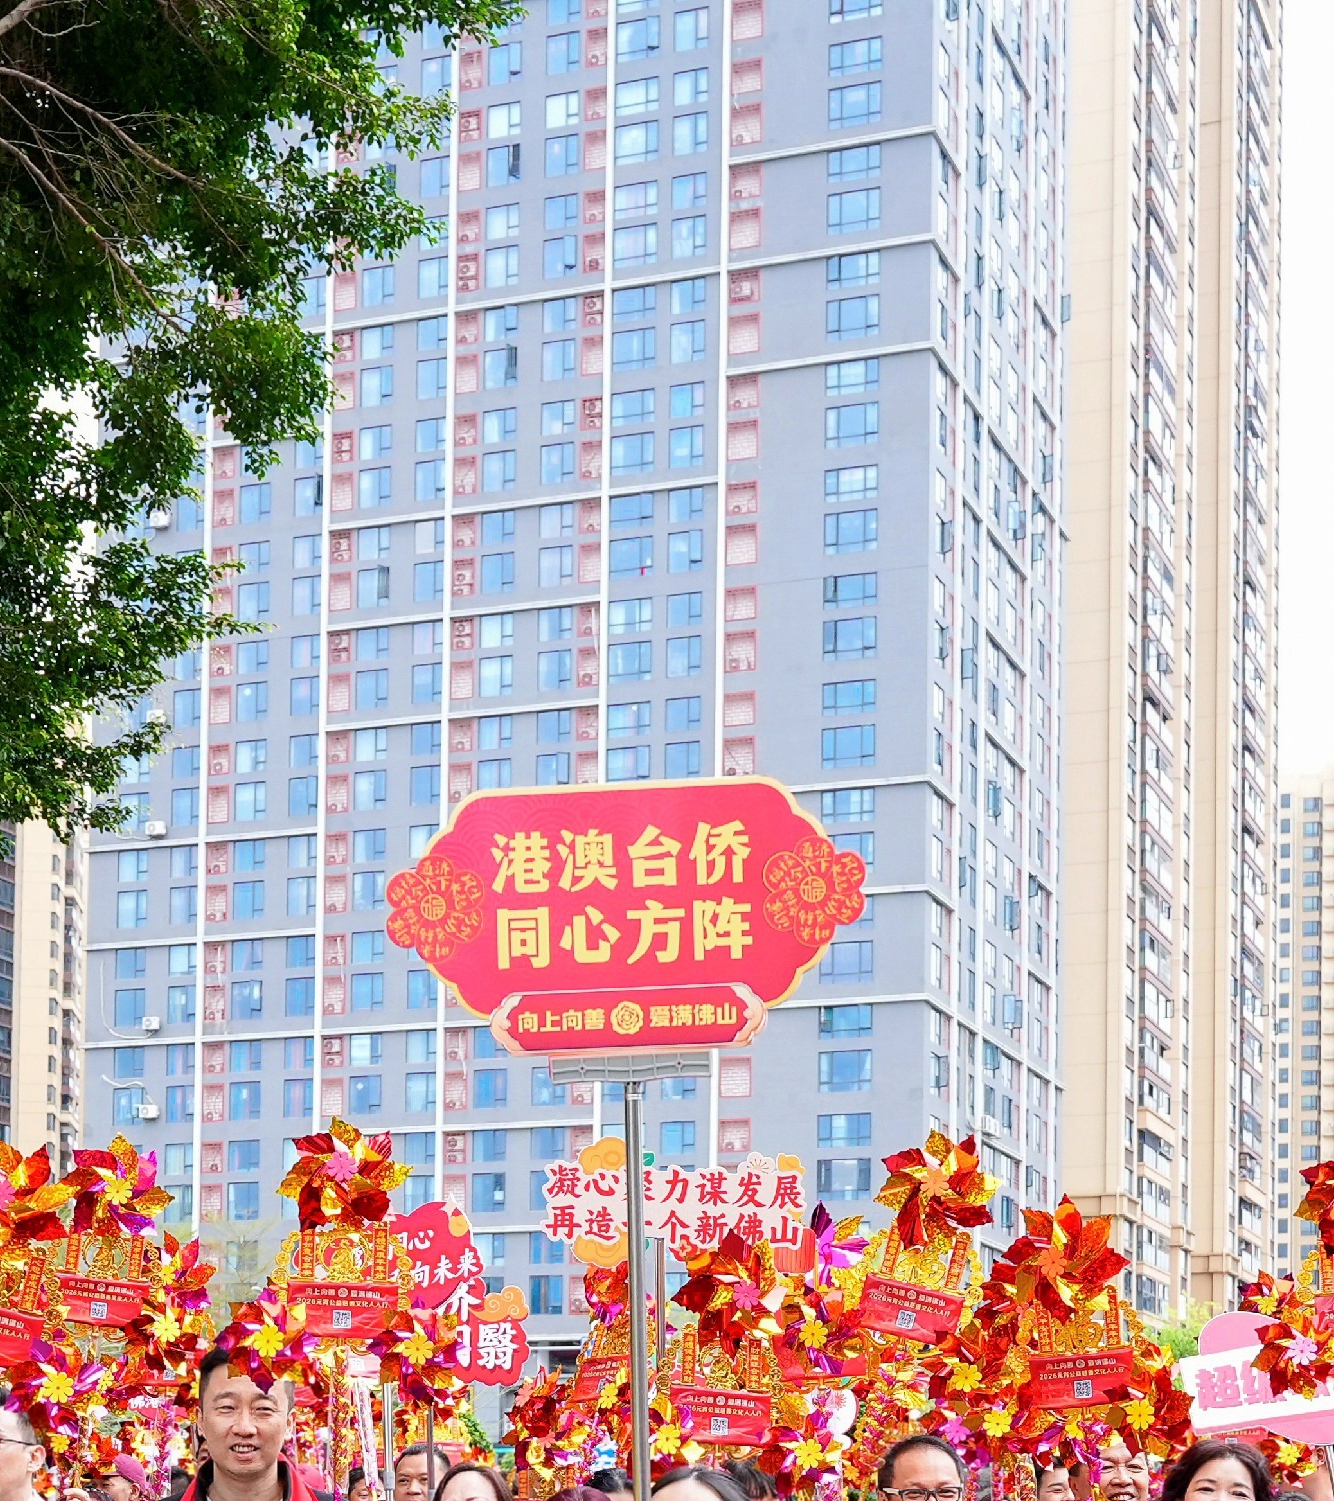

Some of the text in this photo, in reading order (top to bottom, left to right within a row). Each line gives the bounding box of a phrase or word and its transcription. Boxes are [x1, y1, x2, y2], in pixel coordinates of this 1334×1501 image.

[490, 820, 753, 894] 港澳台侨
[497, 897, 754, 971] 同心方阵
[517, 1001, 738, 1035] 向上向善 爱满佛山
